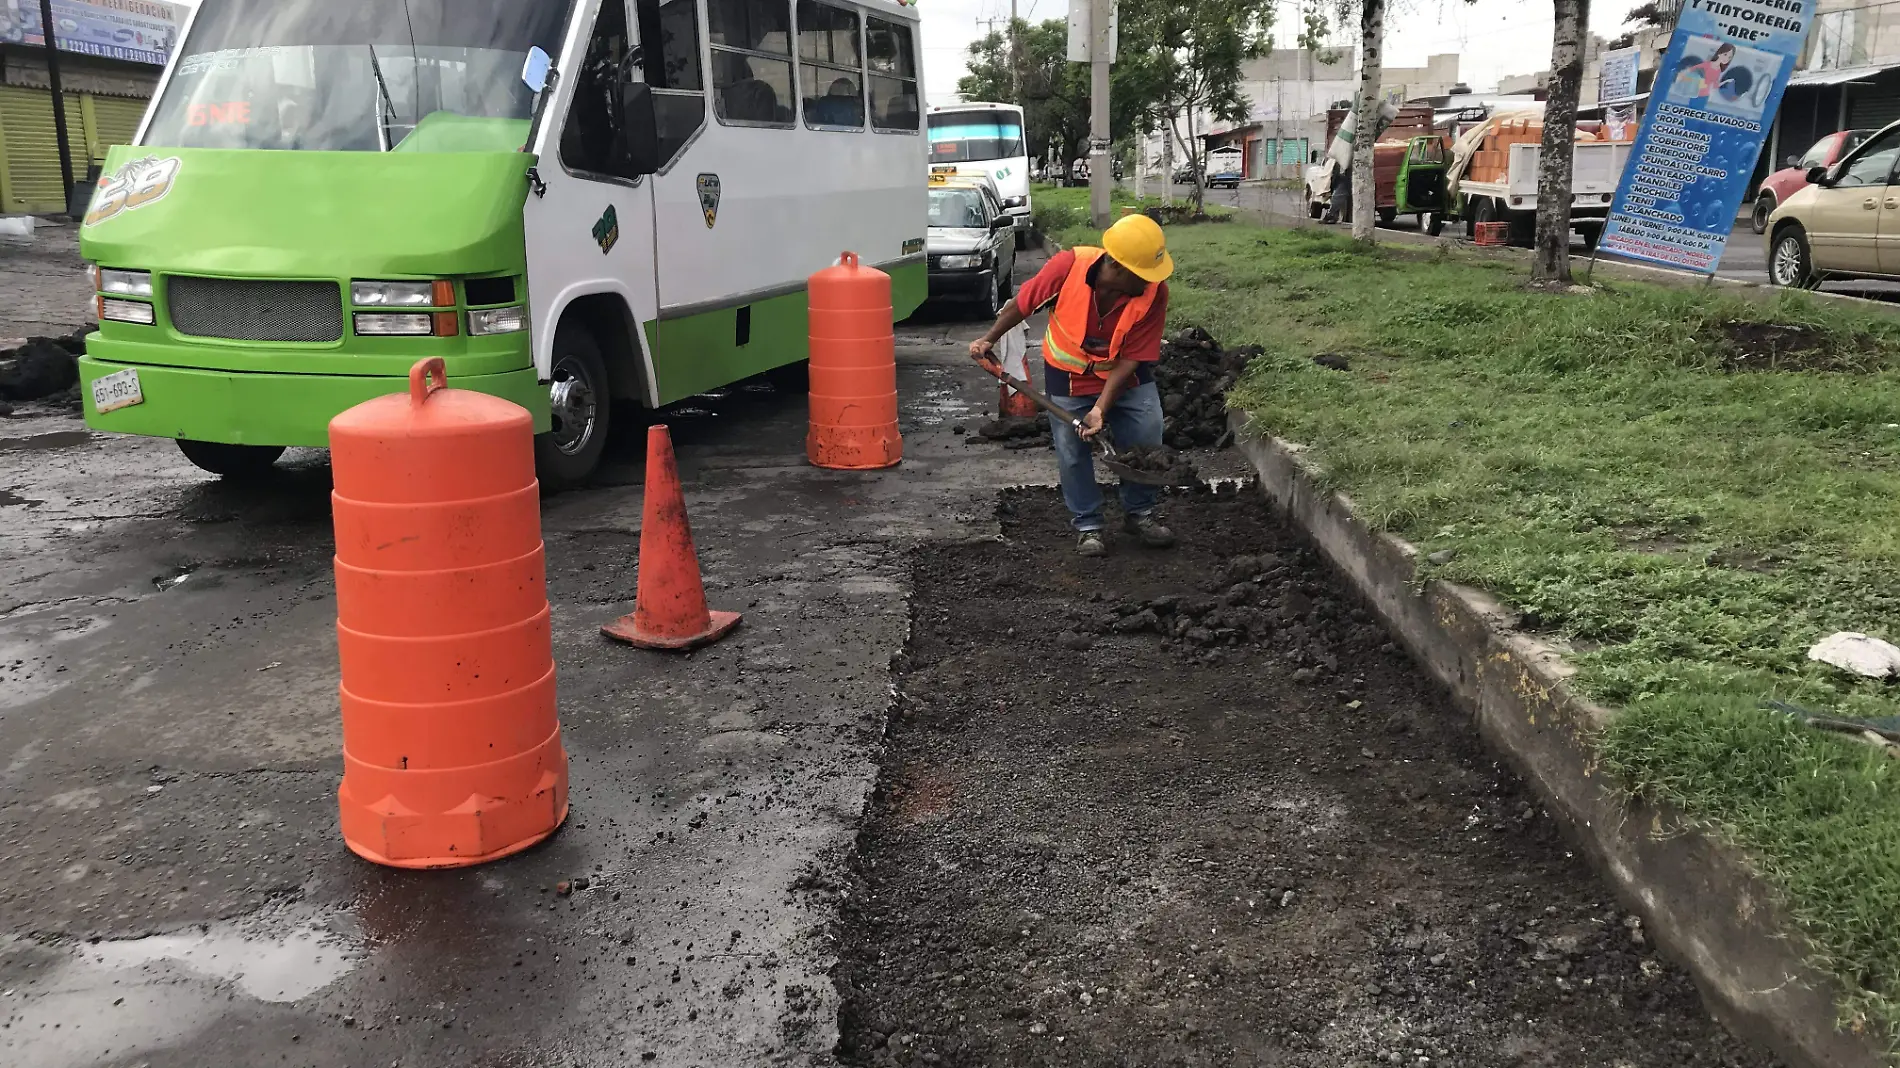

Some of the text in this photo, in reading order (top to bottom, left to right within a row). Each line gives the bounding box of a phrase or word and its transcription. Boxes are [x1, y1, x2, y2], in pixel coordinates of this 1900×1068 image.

[1692, 0, 1802, 32] Y TINTORERÍA
[1659, 103, 1671, 113] LE
[1672, 105, 1707, 120] OFRECE
[1708, 113, 1745, 128] LAVADO
[1656, 125, 1711, 142] CHAMARRAS
[1653, 135, 1709, 153] COBERTORES
[1649, 145, 1702, 162] EDREDONES
[996, 166, 1012, 180] 01
[1645, 155, 1727, 178] FUNDAS DE CARRO
[1627, 205, 1684, 222] PLANCHADO
[1611, 214, 1631, 224] LUNES
[1639, 219, 1665, 230] VIERNES
[1667, 226, 1682, 234] 9:00
[1652, 244, 1683, 255] MERCADO
